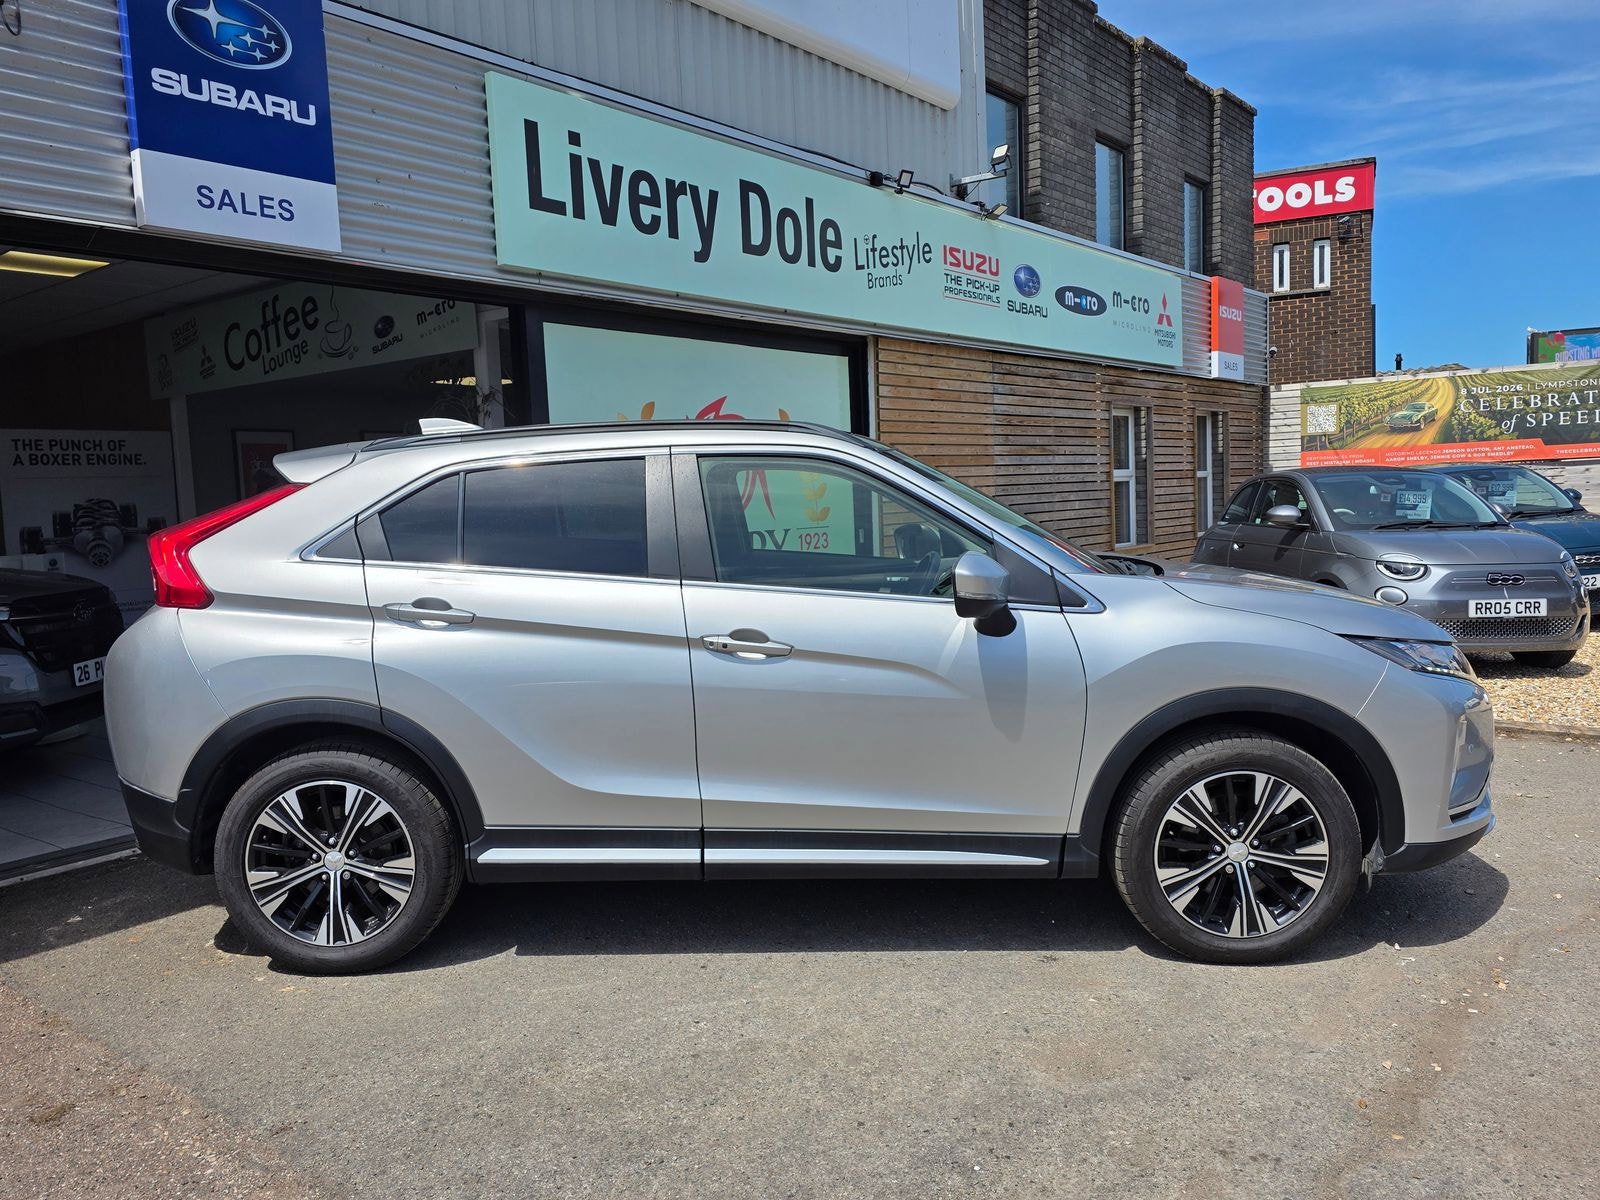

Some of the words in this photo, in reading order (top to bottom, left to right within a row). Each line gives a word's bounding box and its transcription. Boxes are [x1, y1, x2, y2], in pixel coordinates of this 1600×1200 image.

[150, 67, 317, 126] SUBARU
[196, 184, 295, 222] SALES
[523, 118, 719, 263] Livery
[739, 178, 843, 273] Dole
[1253, 175, 1356, 212] OOLS
[854, 231, 933, 274] Lifestyle
[943, 244, 1000, 277] ISUZU
[867, 268, 903, 289] Brands
[944, 272, 962, 287] THE
[966, 277, 1000, 294] PICK-UP
[944, 285, 1001, 304] PROFESSIONALS
[1007, 299, 1048, 318] SUBARU
[1219, 304, 1242, 321] ISUZU
[224, 293, 319, 371] Coffee
[372, 333, 403, 354] SUBARU
[261, 340, 309, 375] Lounge
[1223, 361, 1239, 372] SALES
[1461, 387, 1467, 395] 8
[1471, 386, 1492, 395] JUL
[1496, 383, 1523, 393] 2026
[1535, 378, 1600, 390] LYMPSTON
[1461, 389, 1598, 413] CELEBRAT
[1502, 413, 1520, 434] of
[11, 439, 44, 451] THE
[48, 439, 103, 451] PUNCH
[107, 439, 126, 451] OF
[12, 453, 25, 466] A
[29, 453, 83, 466] BOXER
[86, 453, 147, 466] ENGINE.
[798, 532, 829, 551] 1923
[1486, 572, 1526, 586] 500
[1475, 602, 1511, 615] RR05
[1515, 601, 1541, 614] CRR
[76, 664, 90, 682] 26
